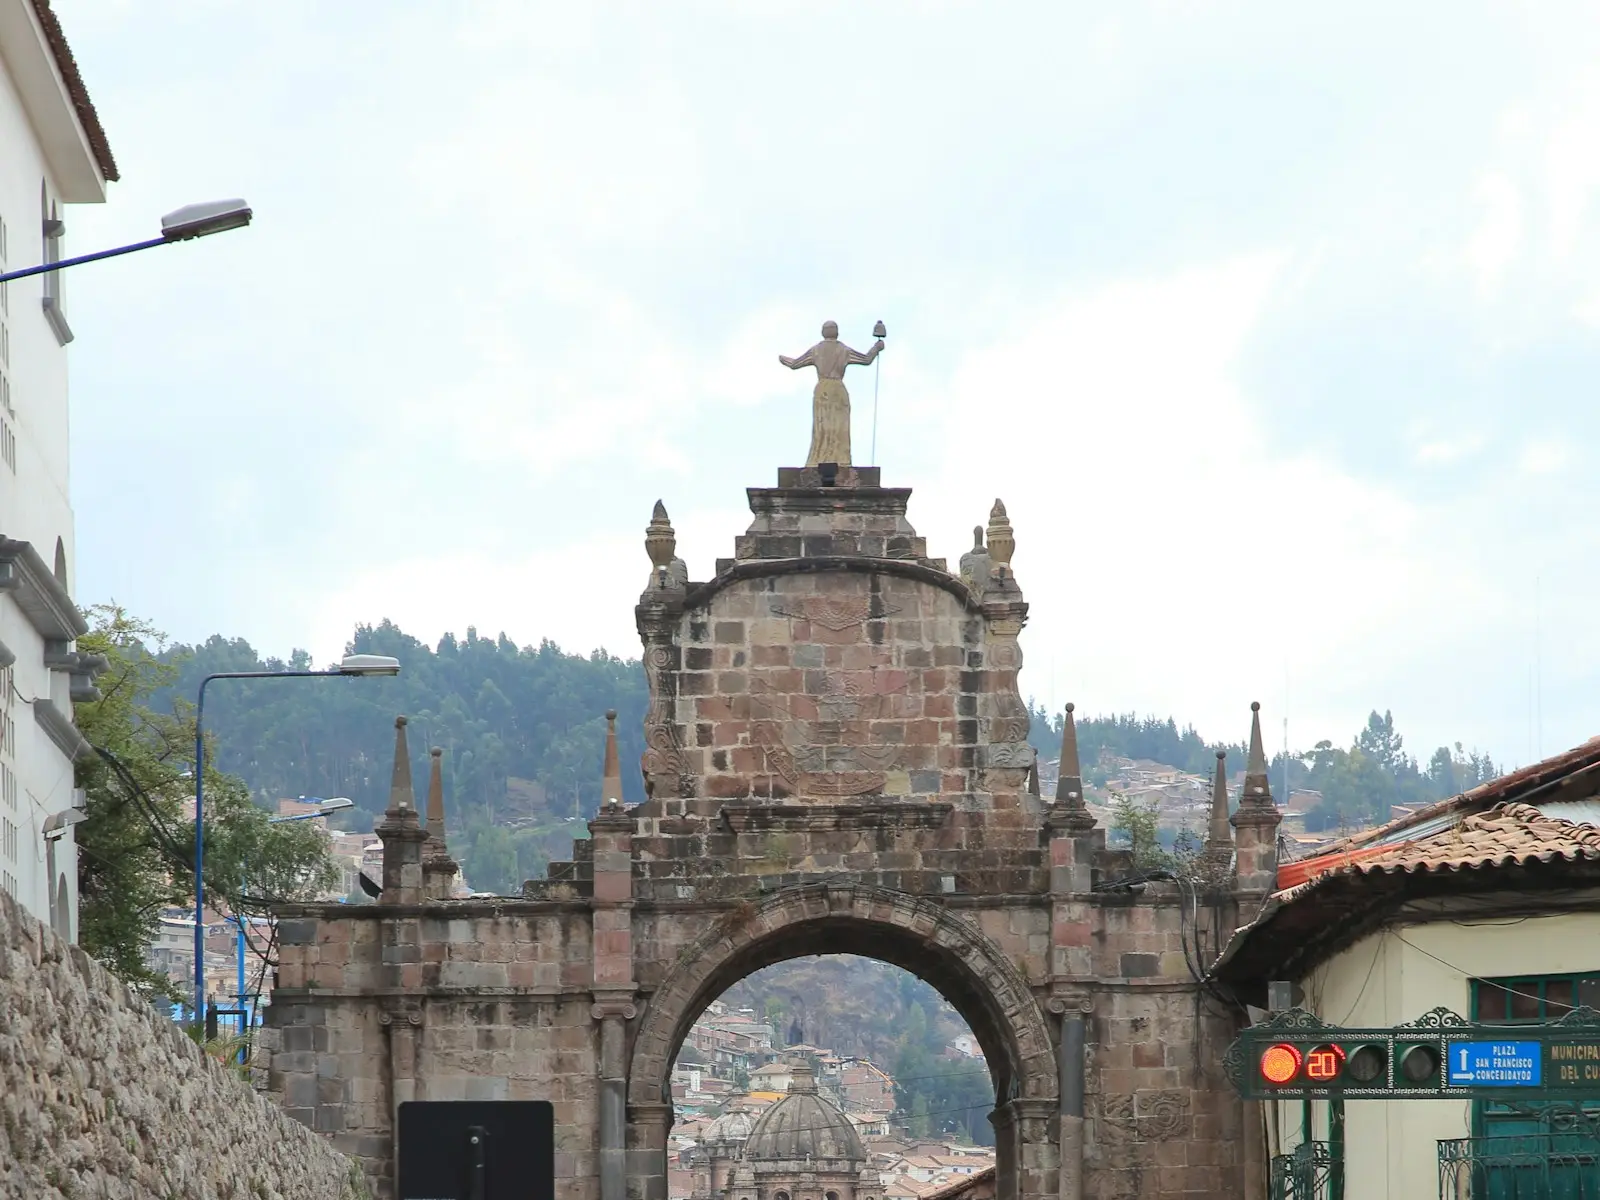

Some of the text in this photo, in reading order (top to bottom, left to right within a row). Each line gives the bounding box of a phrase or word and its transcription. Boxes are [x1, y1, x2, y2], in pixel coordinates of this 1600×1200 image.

[1493, 1045, 1516, 1056] PLAZA
[1551, 1045, 1600, 1060] MUNICIPA
[1308, 1052, 1336, 1077] 20
[1475, 1058, 1533, 1069] SAN FRANCISCO
[1560, 1064, 1600, 1080] DEL CU
